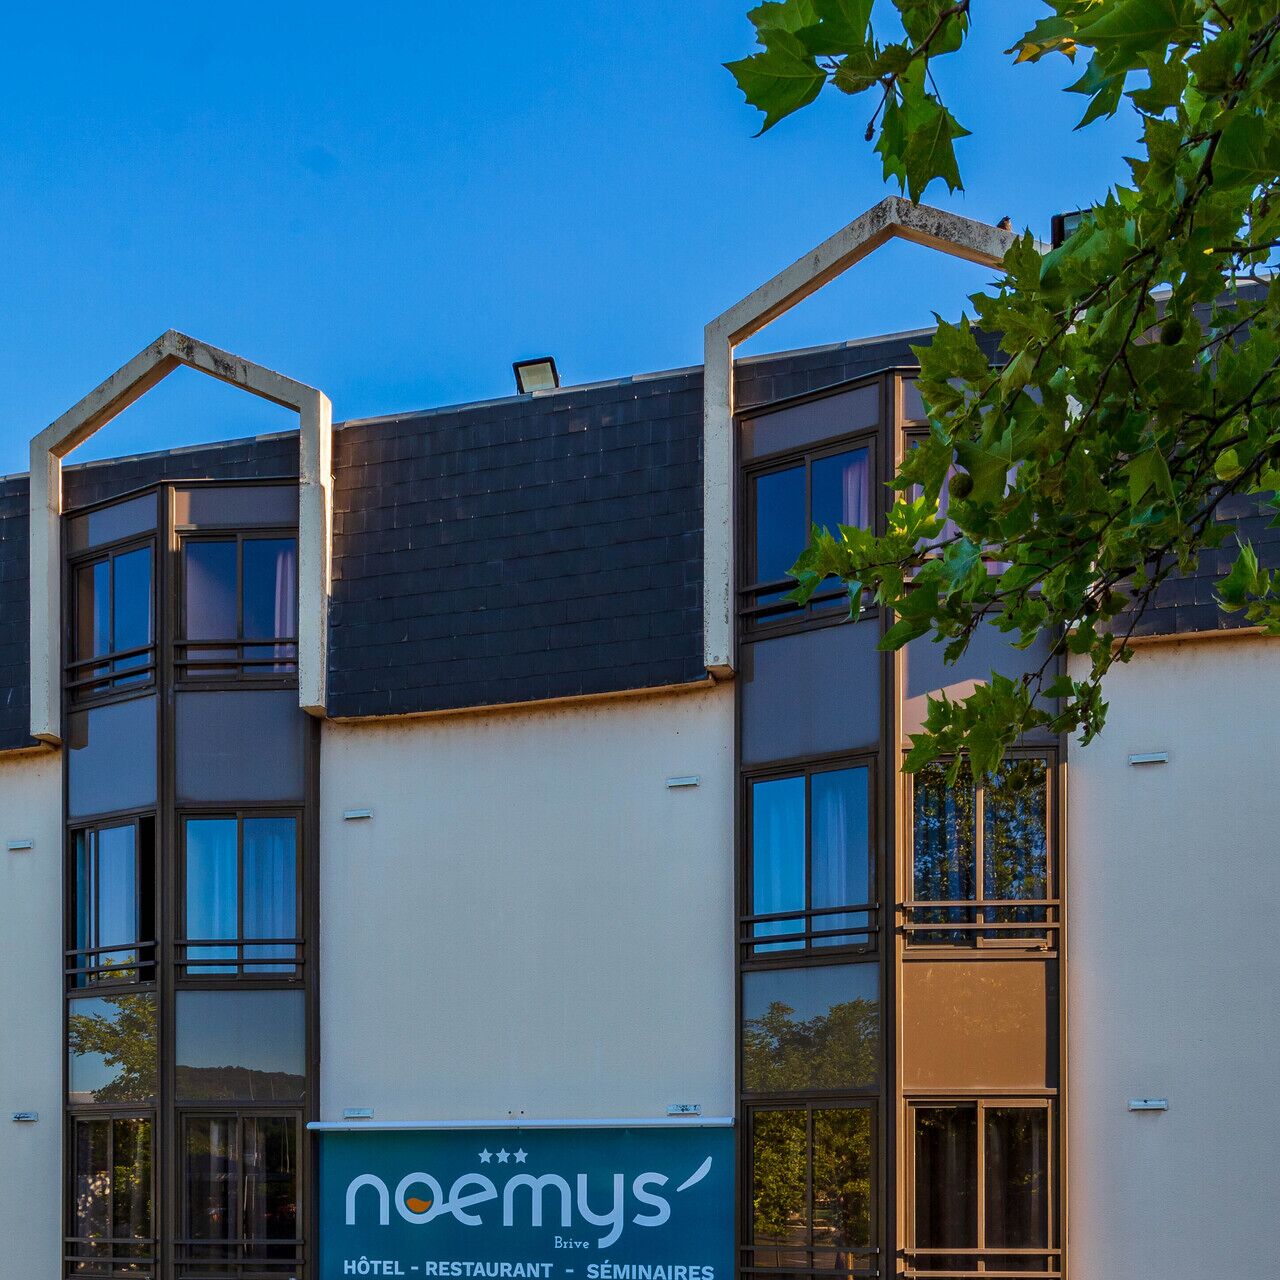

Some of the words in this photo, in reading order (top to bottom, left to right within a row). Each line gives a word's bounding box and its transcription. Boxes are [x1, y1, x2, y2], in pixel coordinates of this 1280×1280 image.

[554, 1236, 590, 1250] Brive
[343, 1255, 405, 1276] HÔTEL
[425, 1261, 554, 1279] RESTAURANT
